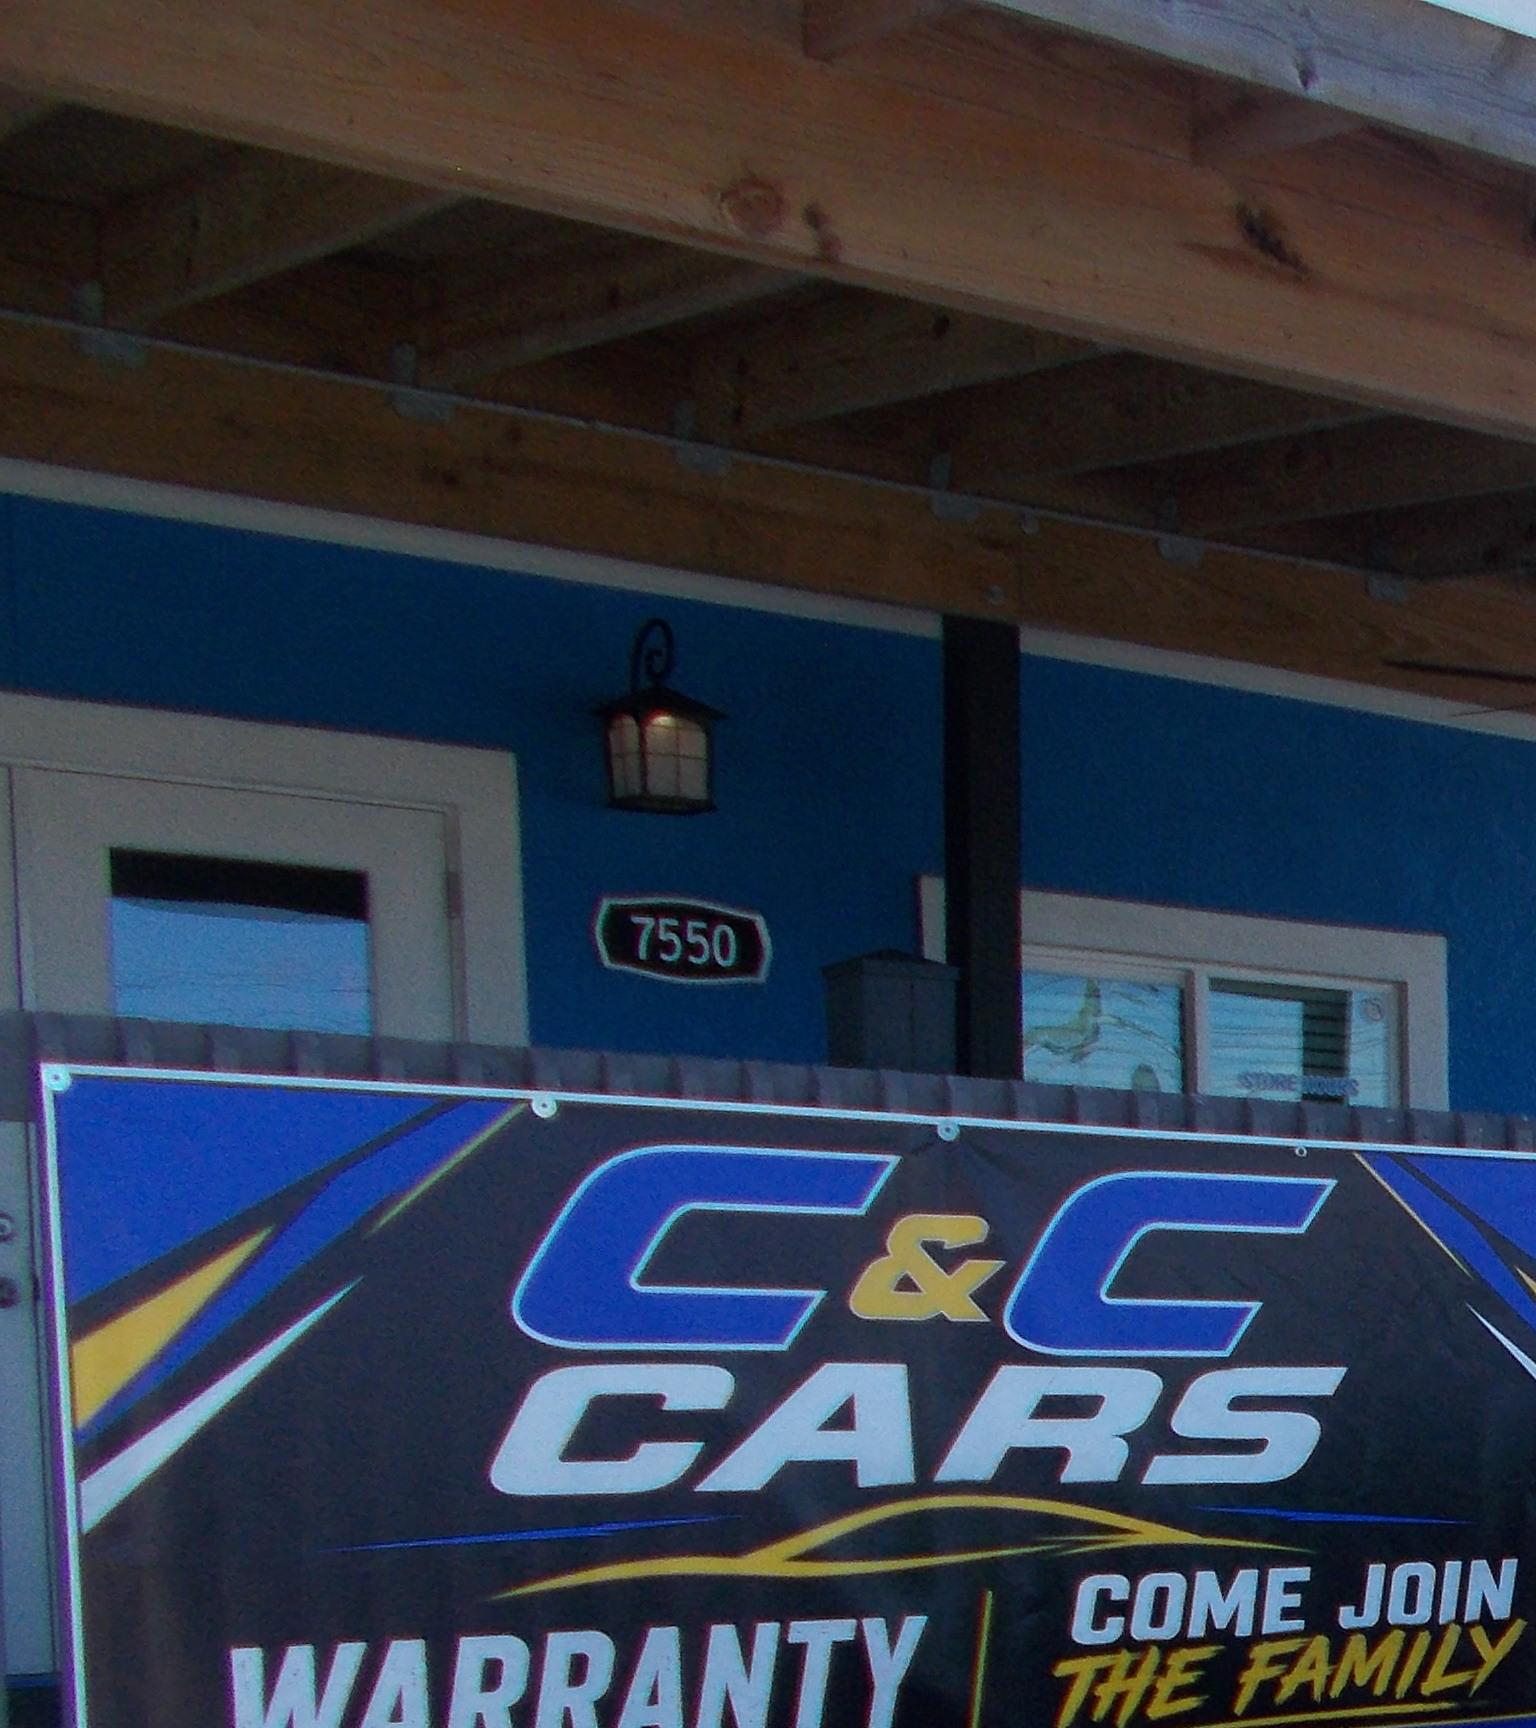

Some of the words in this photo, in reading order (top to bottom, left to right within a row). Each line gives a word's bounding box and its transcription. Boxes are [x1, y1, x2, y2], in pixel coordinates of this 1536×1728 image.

[630, 914, 737, 968] 7550
[489, 1362, 1348, 1496] CARS
[1070, 1565, 1312, 1647] COME
[1337, 1557, 1520, 1631] JOIN
[1232, 1618, 1528, 1717] FAMILY
